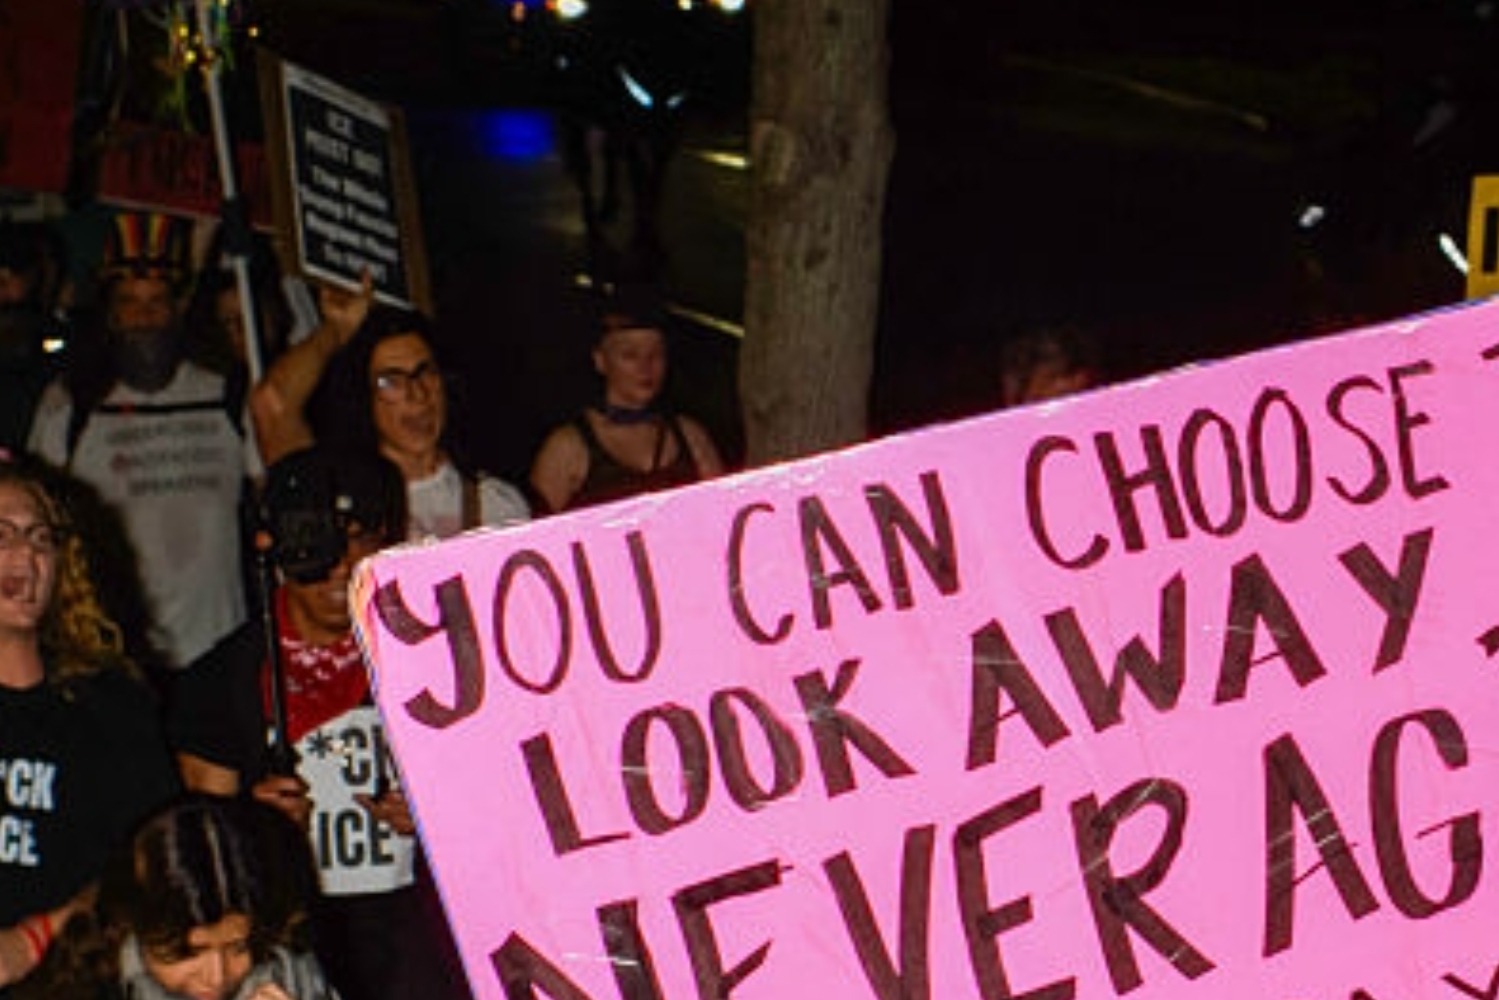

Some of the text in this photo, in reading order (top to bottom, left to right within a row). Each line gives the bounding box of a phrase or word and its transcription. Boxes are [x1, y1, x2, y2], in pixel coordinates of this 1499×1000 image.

[378, 532, 660, 729] YOU
[729, 473, 957, 643] CAN
[1026, 361, 1448, 568] CHOOSE
[521, 661, 914, 854] LOOK
[0, 814, 41, 867] CE
[317, 806, 396, 870] ICE
